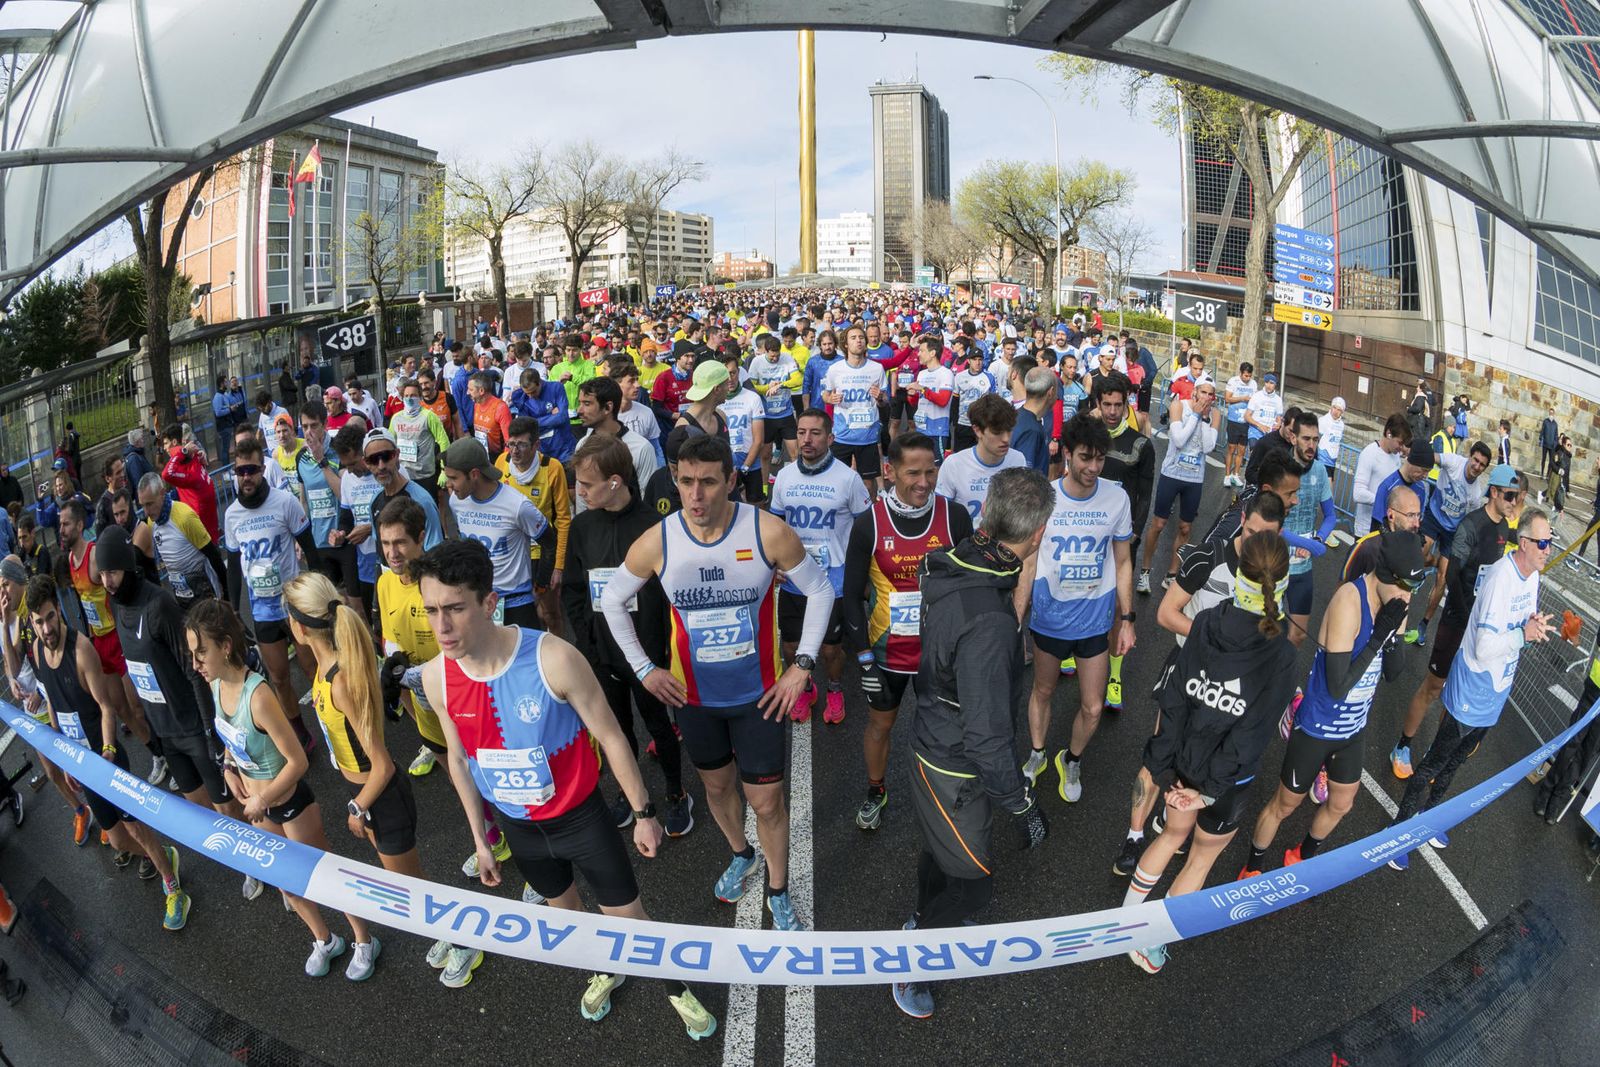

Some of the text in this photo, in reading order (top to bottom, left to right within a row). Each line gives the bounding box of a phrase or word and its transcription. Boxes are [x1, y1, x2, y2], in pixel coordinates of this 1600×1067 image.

[1276, 229, 1298, 239] Burgos
[727, 414, 747, 429] 024
[852, 414, 871, 422] 1218
[799, 484, 835, 493] CARRERA
[311, 499, 331, 509] 3532
[247, 515, 275, 525] CARRERA
[470, 513, 502, 521] CARRERA
[470, 519, 490, 527] AGUA
[785, 505, 837, 529] 2024
[238, 523, 266, 534] DEL AGUA
[1051, 535, 1110, 561] 2024
[699, 565, 725, 582] Tuda
[1065, 567, 1099, 579] 2198
[253, 576, 280, 588] 3508
[717, 587, 759, 601] BOSTON
[738, 608, 748, 617] 10
[702, 627, 741, 645] 237
[137, 677, 151, 690] 83
[1186, 678, 1247, 716] addas
[64, 725, 80, 739] 547
[54, 738, 77, 758] MADRID
[532, 752, 543, 761] 10
[114, 768, 151, 794] de Madrid
[493, 770, 541, 787] 262
[110, 778, 146, 806] Comunidad
[223, 824, 266, 845] Isabel
[265, 838, 286, 851] de
[1361, 833, 1411, 859] de Madrid
[1370, 838, 1421, 863] Comunidad
[232, 840, 275, 868] Canal
[1275, 872, 1297, 886] de
[1224, 880, 1277, 904] Isabel
[1260, 884, 1310, 906] Canal
[425, 893, 1042, 975] CARRERA DEL AGUA
